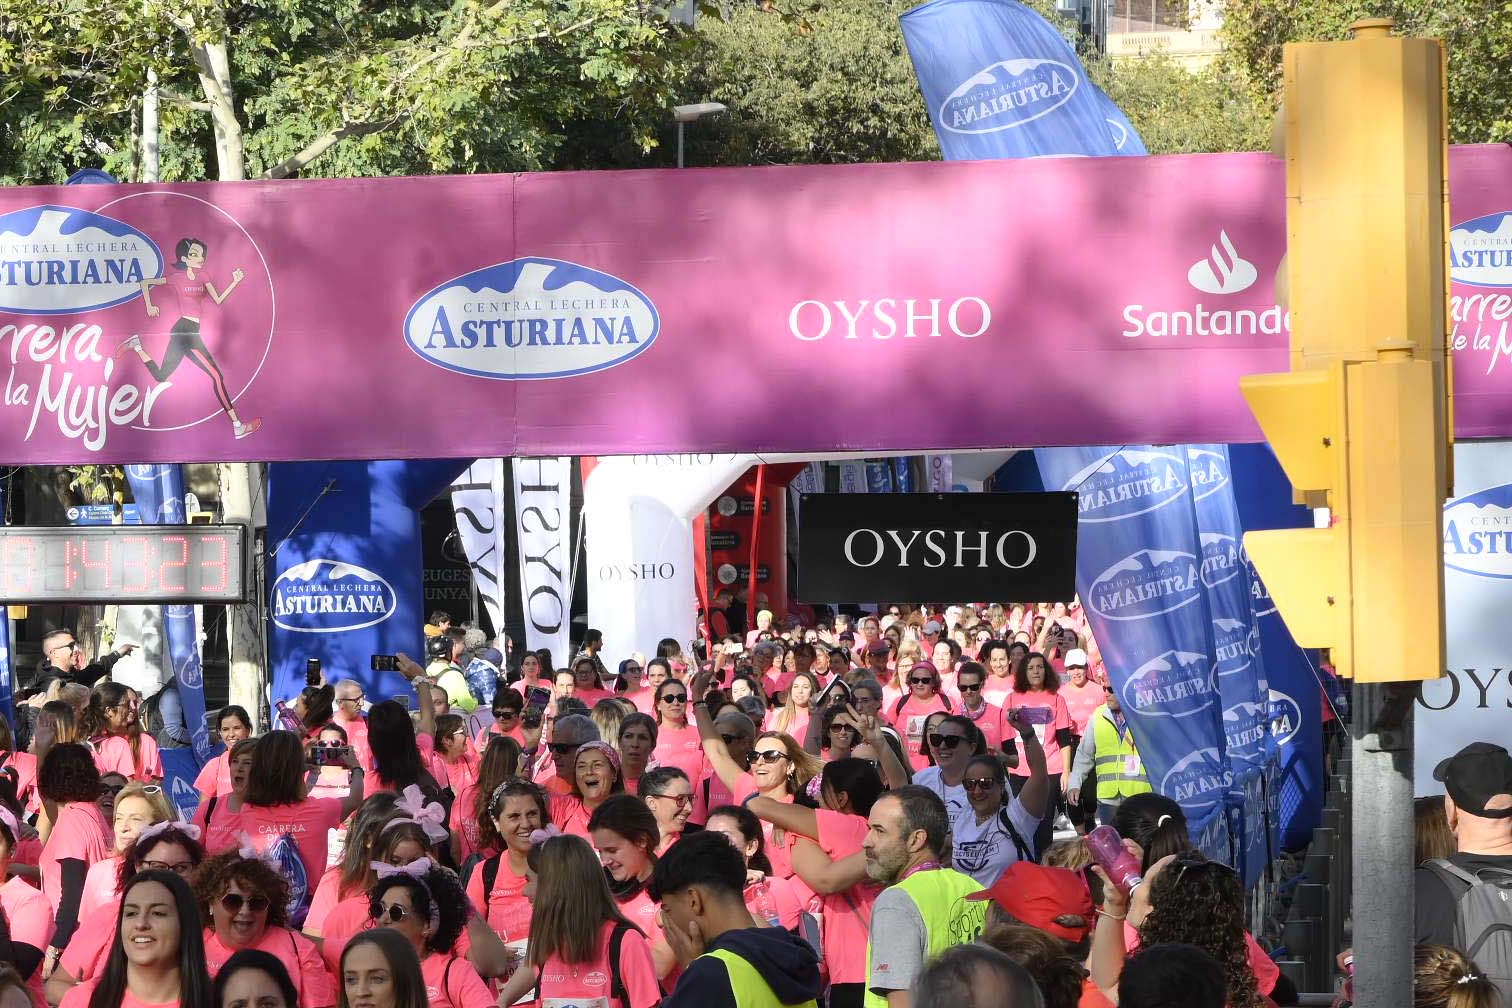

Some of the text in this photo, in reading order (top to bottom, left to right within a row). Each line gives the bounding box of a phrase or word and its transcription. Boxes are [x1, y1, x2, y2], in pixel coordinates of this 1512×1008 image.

[66, 241, 139, 253] LECHERA
[463, 298, 631, 312] CENTRAL LECHERA
[789, 297, 992, 340] OYSHO
[424, 304, 640, 349] ASTURIANA
[5, 366, 30, 406] la
[24, 357, 173, 451] Mujer
[4, 537, 229, 592] 01:43:23
[844, 528, 1037, 568] OYSHO
[287, 584, 383, 593] CENTRAL LECHERA
[600, 563, 675, 580] OYSHO
[274, 588, 387, 617] ASTURIANA
[1416, 668, 1512, 710] OY
